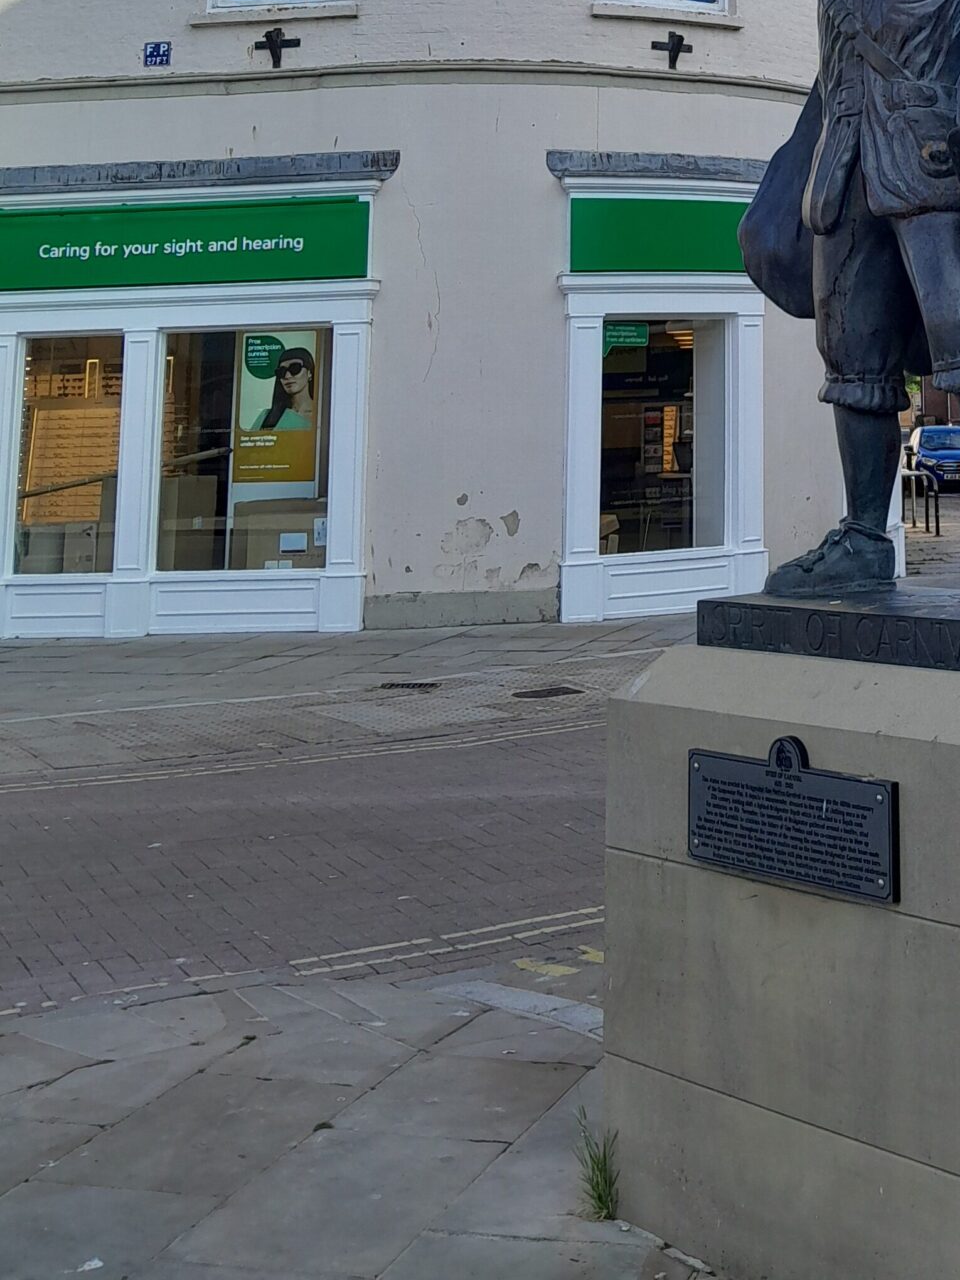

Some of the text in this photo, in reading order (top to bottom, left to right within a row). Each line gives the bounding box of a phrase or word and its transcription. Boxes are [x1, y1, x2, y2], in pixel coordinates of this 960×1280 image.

[39, 234, 304, 260] Caring for your sight and hearing
[711, 604, 792, 649] SPIRIT
[805, 612, 841, 656] OF
